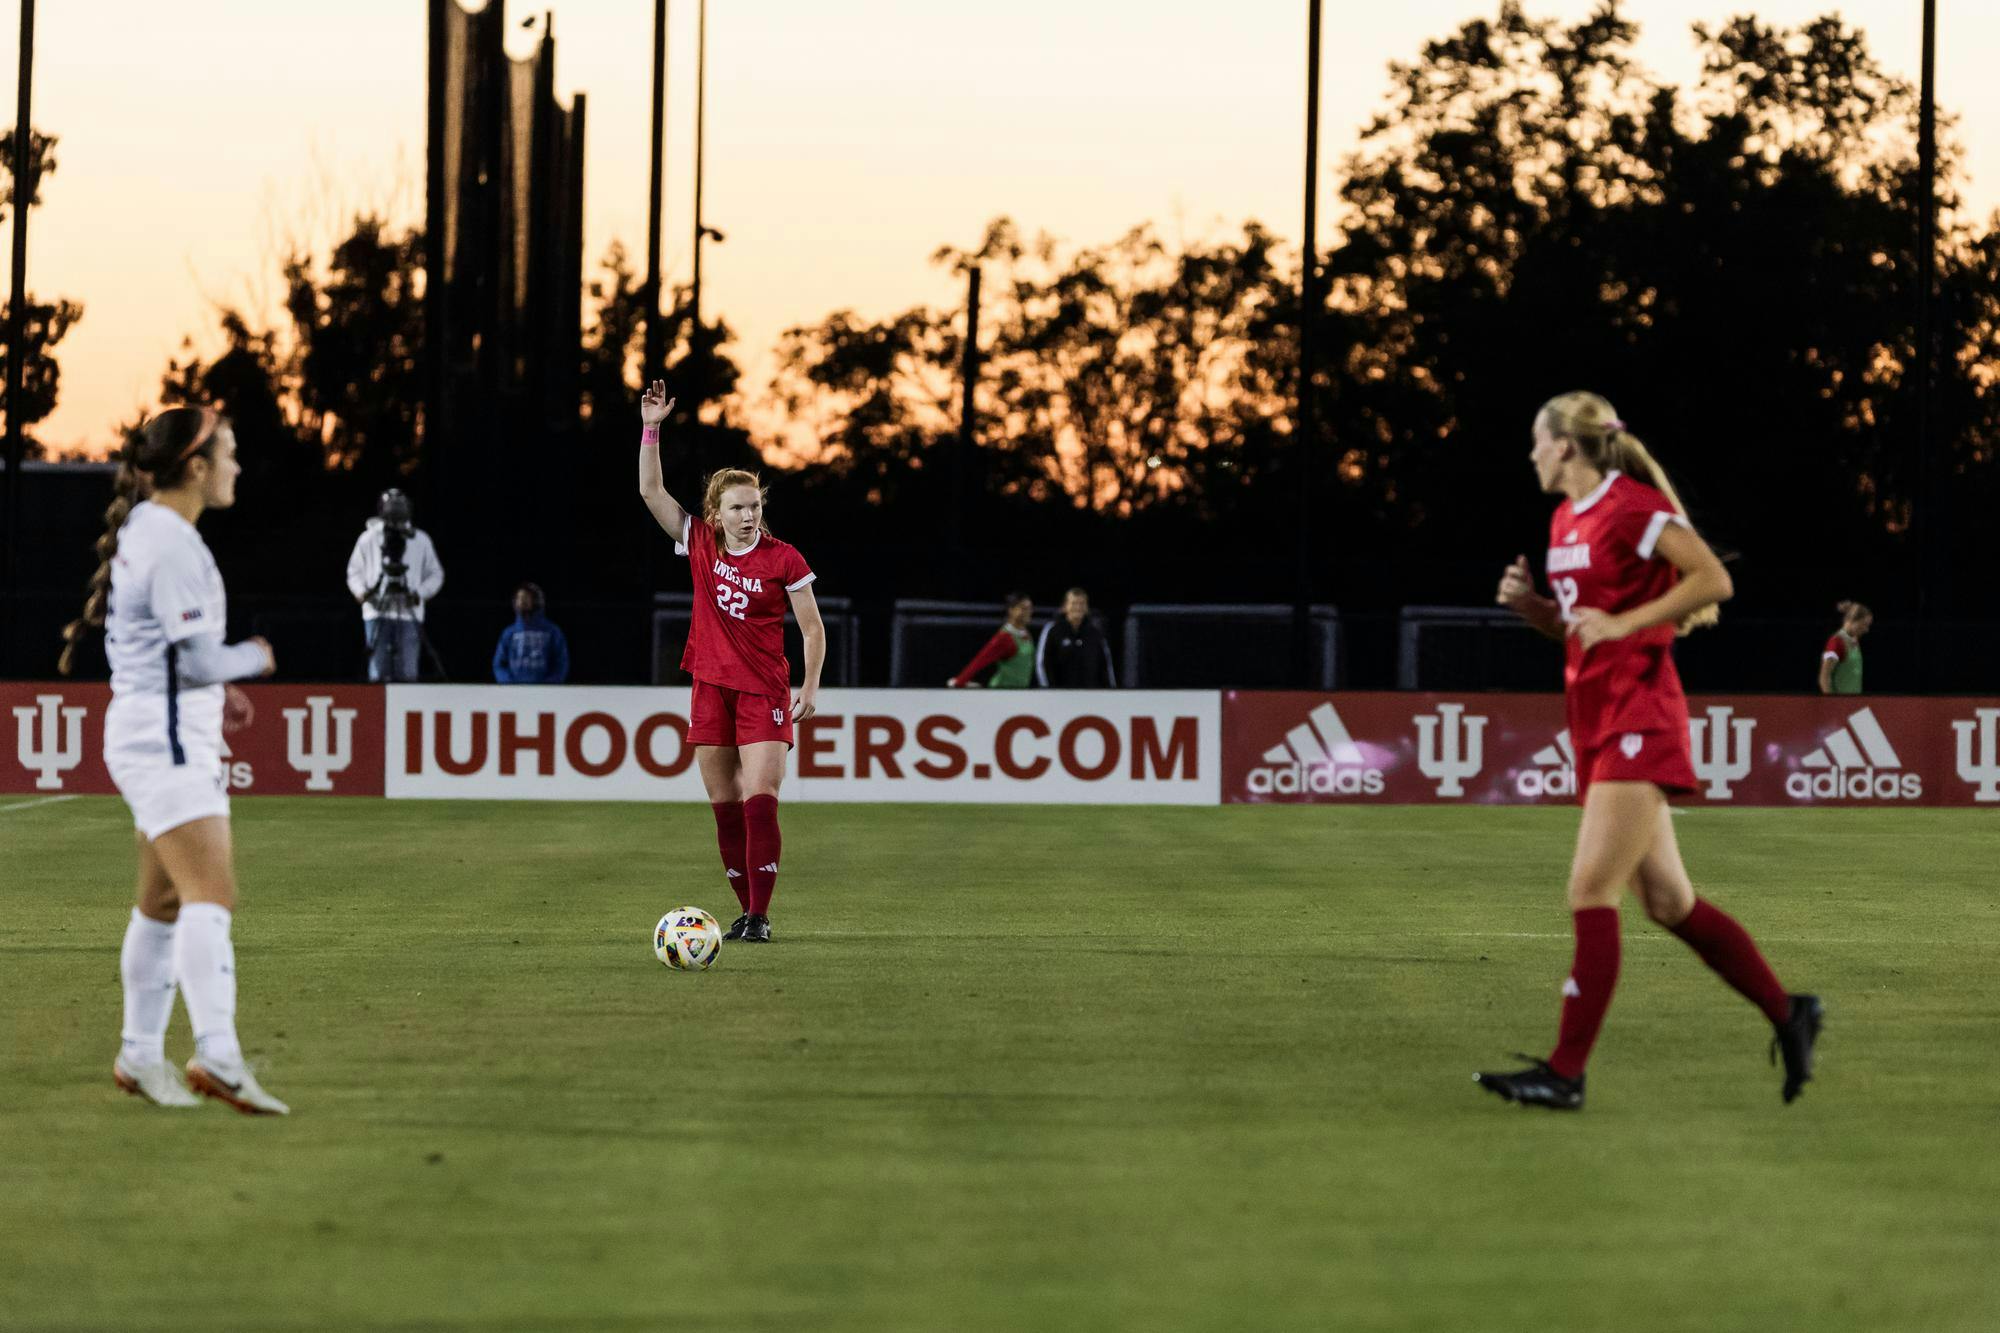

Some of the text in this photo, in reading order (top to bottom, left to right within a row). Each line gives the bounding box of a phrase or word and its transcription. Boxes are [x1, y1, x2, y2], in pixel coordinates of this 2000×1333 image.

[1546, 542, 1590, 573] DIANA
[716, 583, 750, 621] 22
[12, 694, 88, 790] IU
[282, 696, 358, 791] IU
[405, 710, 1199, 782] IUHOOERS.COM
[1412, 703, 1489, 797] IU
[1247, 762, 1385, 795] adidas
[1516, 763, 1577, 797] adi
[1785, 765, 1923, 799] adidas
